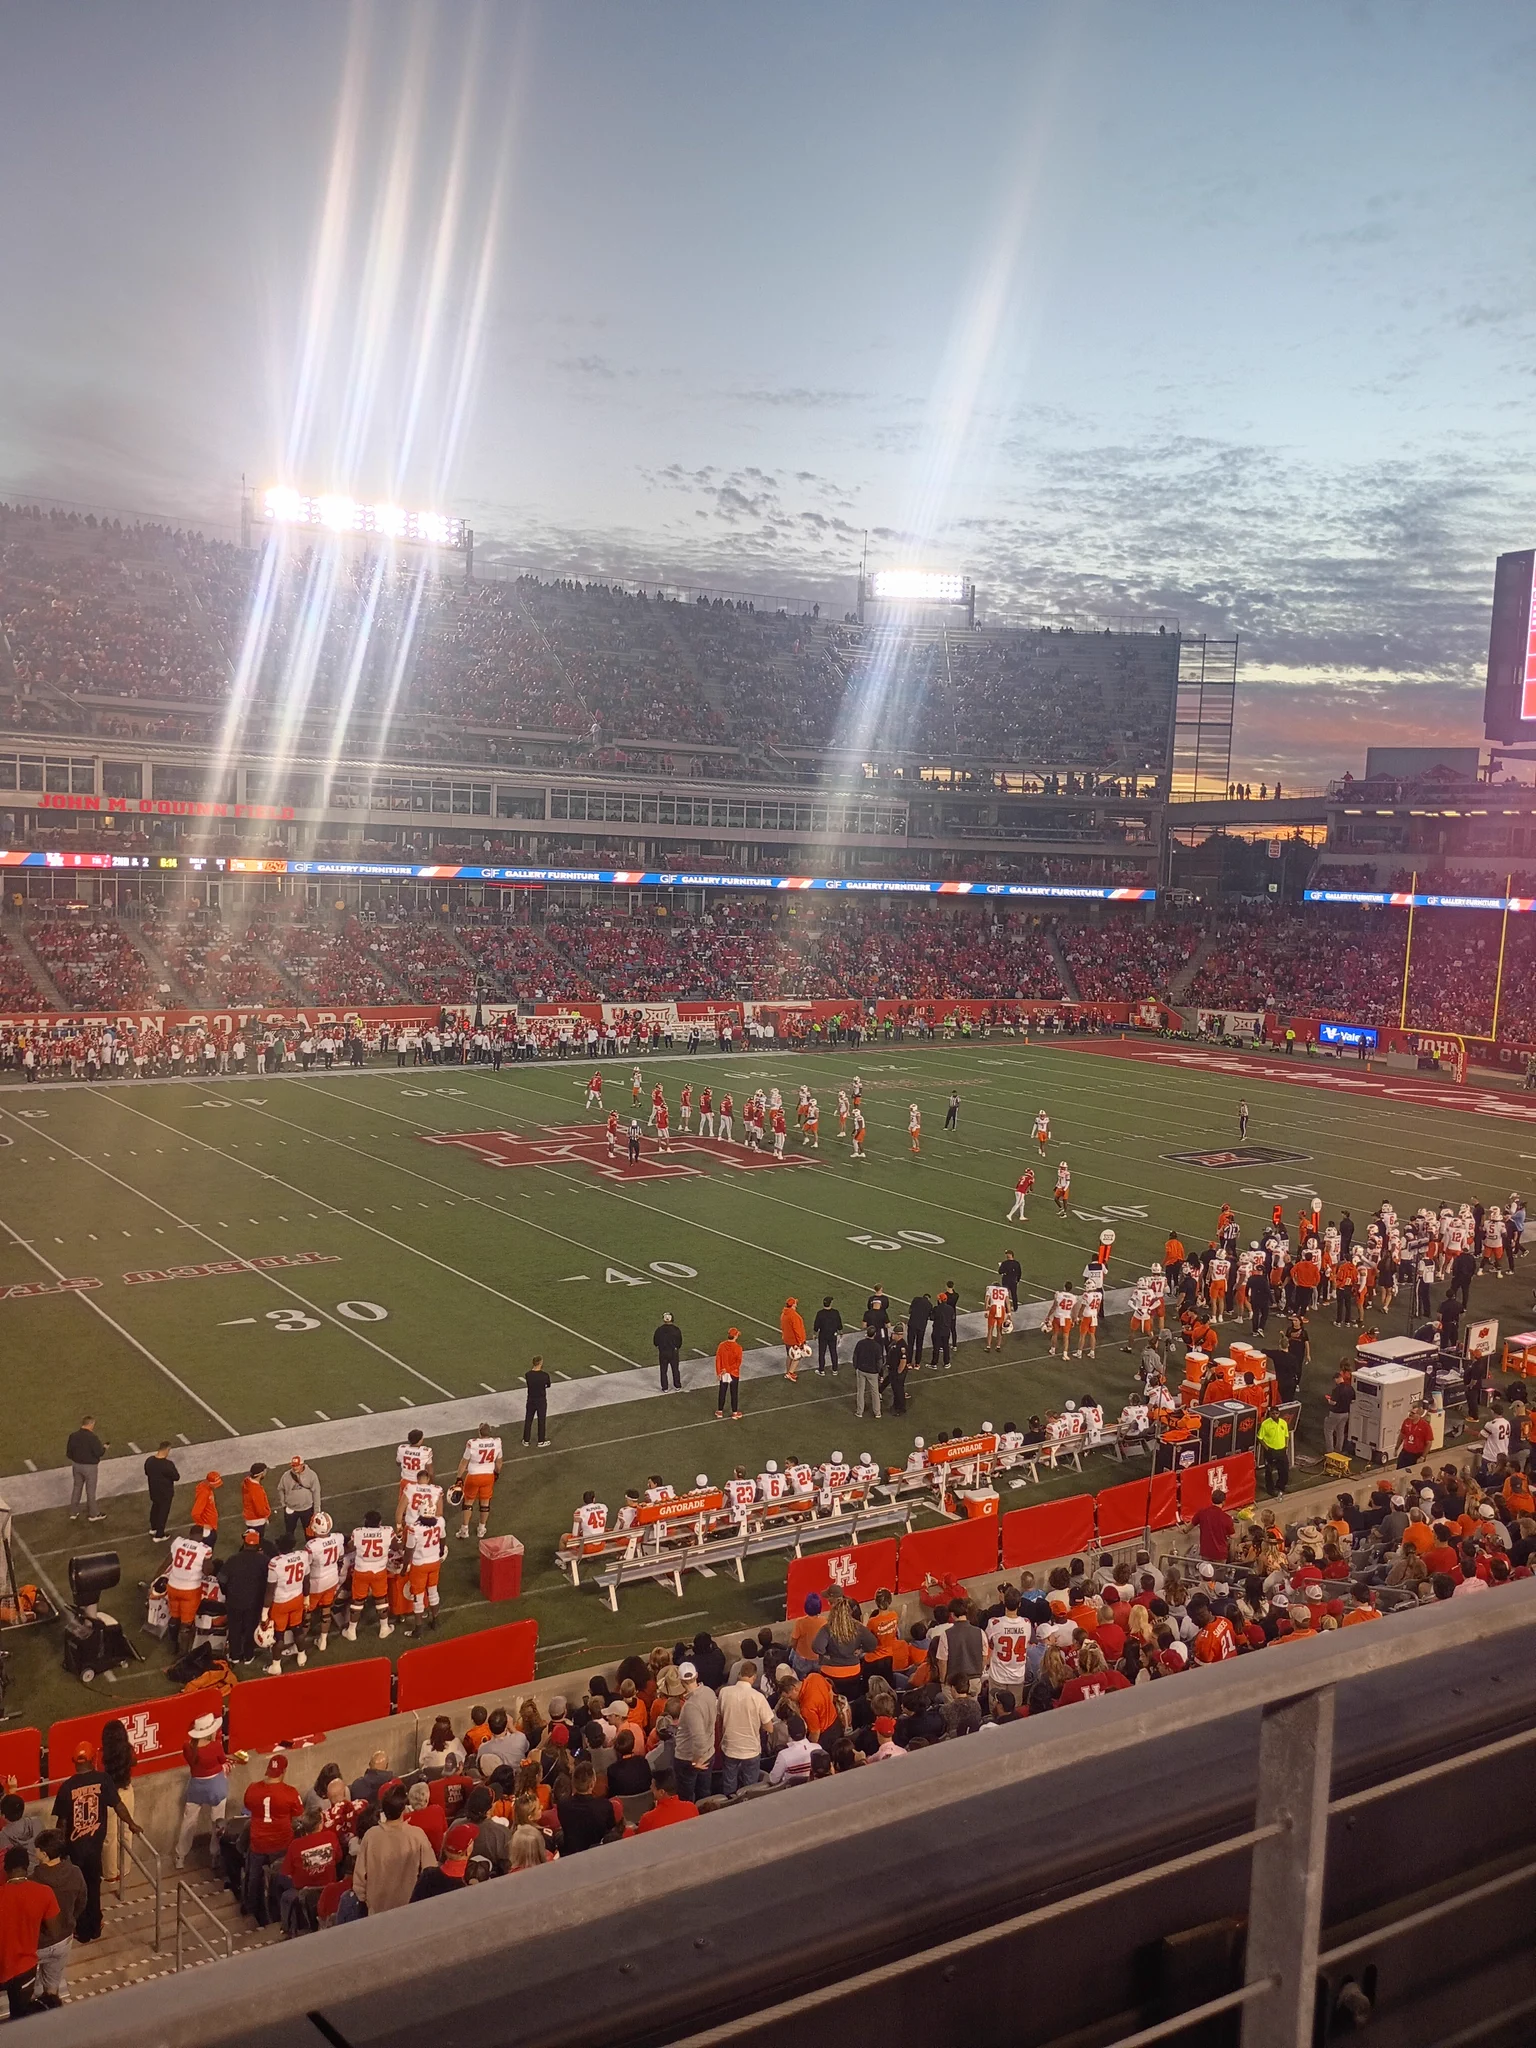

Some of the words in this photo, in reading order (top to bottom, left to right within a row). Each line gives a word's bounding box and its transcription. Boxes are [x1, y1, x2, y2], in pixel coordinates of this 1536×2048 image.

[37, 794, 100, 811] JOHN
[108, 798, 133, 812] M.
[139, 799, 228, 816] O'QUINN
[234, 804, 295, 820] FIELD
[142, 857, 149, 868] 2
[317, 864, 358, 874] GALLERY
[359, 866, 412, 875] FURNITURE
[504, 870, 546, 880] GALLERY
[547, 872, 600, 882] FURNITURE
[681, 876, 721, 885] GALLERY
[722, 877, 772, 887] FURNITURE
[846, 881, 883, 891] GALLERY
[884, 883, 931, 892] FURNITURE
[1009, 886, 1050, 896] GALLERY
[1051, 888, 1104, 898] FURNITURE
[1325, 892, 1352, 901] GALLERY
[1352, 893, 1384, 902] FURNITURE
[1440, 897, 1466, 907] GALLERY
[1466, 898, 1500, 907] FURNITURE
[399, 1087, 469, 1098] 50
[202, 1097, 268, 1109] 40
[1389, 1165, 1462, 1181] 20
[1240, 1183, 1318, 1201] 30
[1071, 1204, 1149, 1223] 40
[1274, 1205, 1282, 1221] 2
[1451, 1231, 1462, 1242] 12
[1488, 1225, 1495, 1234] 5
[845, 1229, 946, 1252] 50
[122, 1252, 343, 1286] TDECU
[605, 1260, 698, 1287] 40
[1216, 1265, 1228, 1275] 50
[992, 1288, 1005, 1300] 85
[1151, 1281, 1162, 1293] 47
[1059, 1299, 1073, 1311] 42
[1141, 1295, 1151, 1307] 15
[264, 1300, 389, 1332] 30
[1261, 1360, 1267, 1368] G
[1228, 1367, 1235, 1377] G
[1092, 1408, 1100, 1422] 3
[1072, 1418, 1080, 1433] 2
[1499, 1424, 1511, 1440] 24
[478, 1449, 495, 1464] 74
[947, 1442, 984, 1457] GATORADE
[403, 1456, 421, 1471] 58
[829, 1471, 846, 1488] 22
[736, 1486, 754, 1504] 23
[770, 1479, 780, 1497] 6
[659, 1499, 705, 1516] GATORADE
[982, 1502, 992, 1514] G
[587, 1510, 606, 1529] 45
[423, 1527, 441, 1549] 73
[361, 1539, 384, 1558] 75
[174, 1547, 198, 1571] 67
[323, 1547, 338, 1567] 71
[284, 1561, 304, 1585] 76
[828, 1554, 858, 1587] UH
[1003, 1627, 1025, 1635] THOMAS
[997, 1635, 1027, 1663] 34
[1220, 1629, 1236, 1660] 21
[117, 1711, 163, 1755] UH
[262, 1796, 273, 1823] 1
